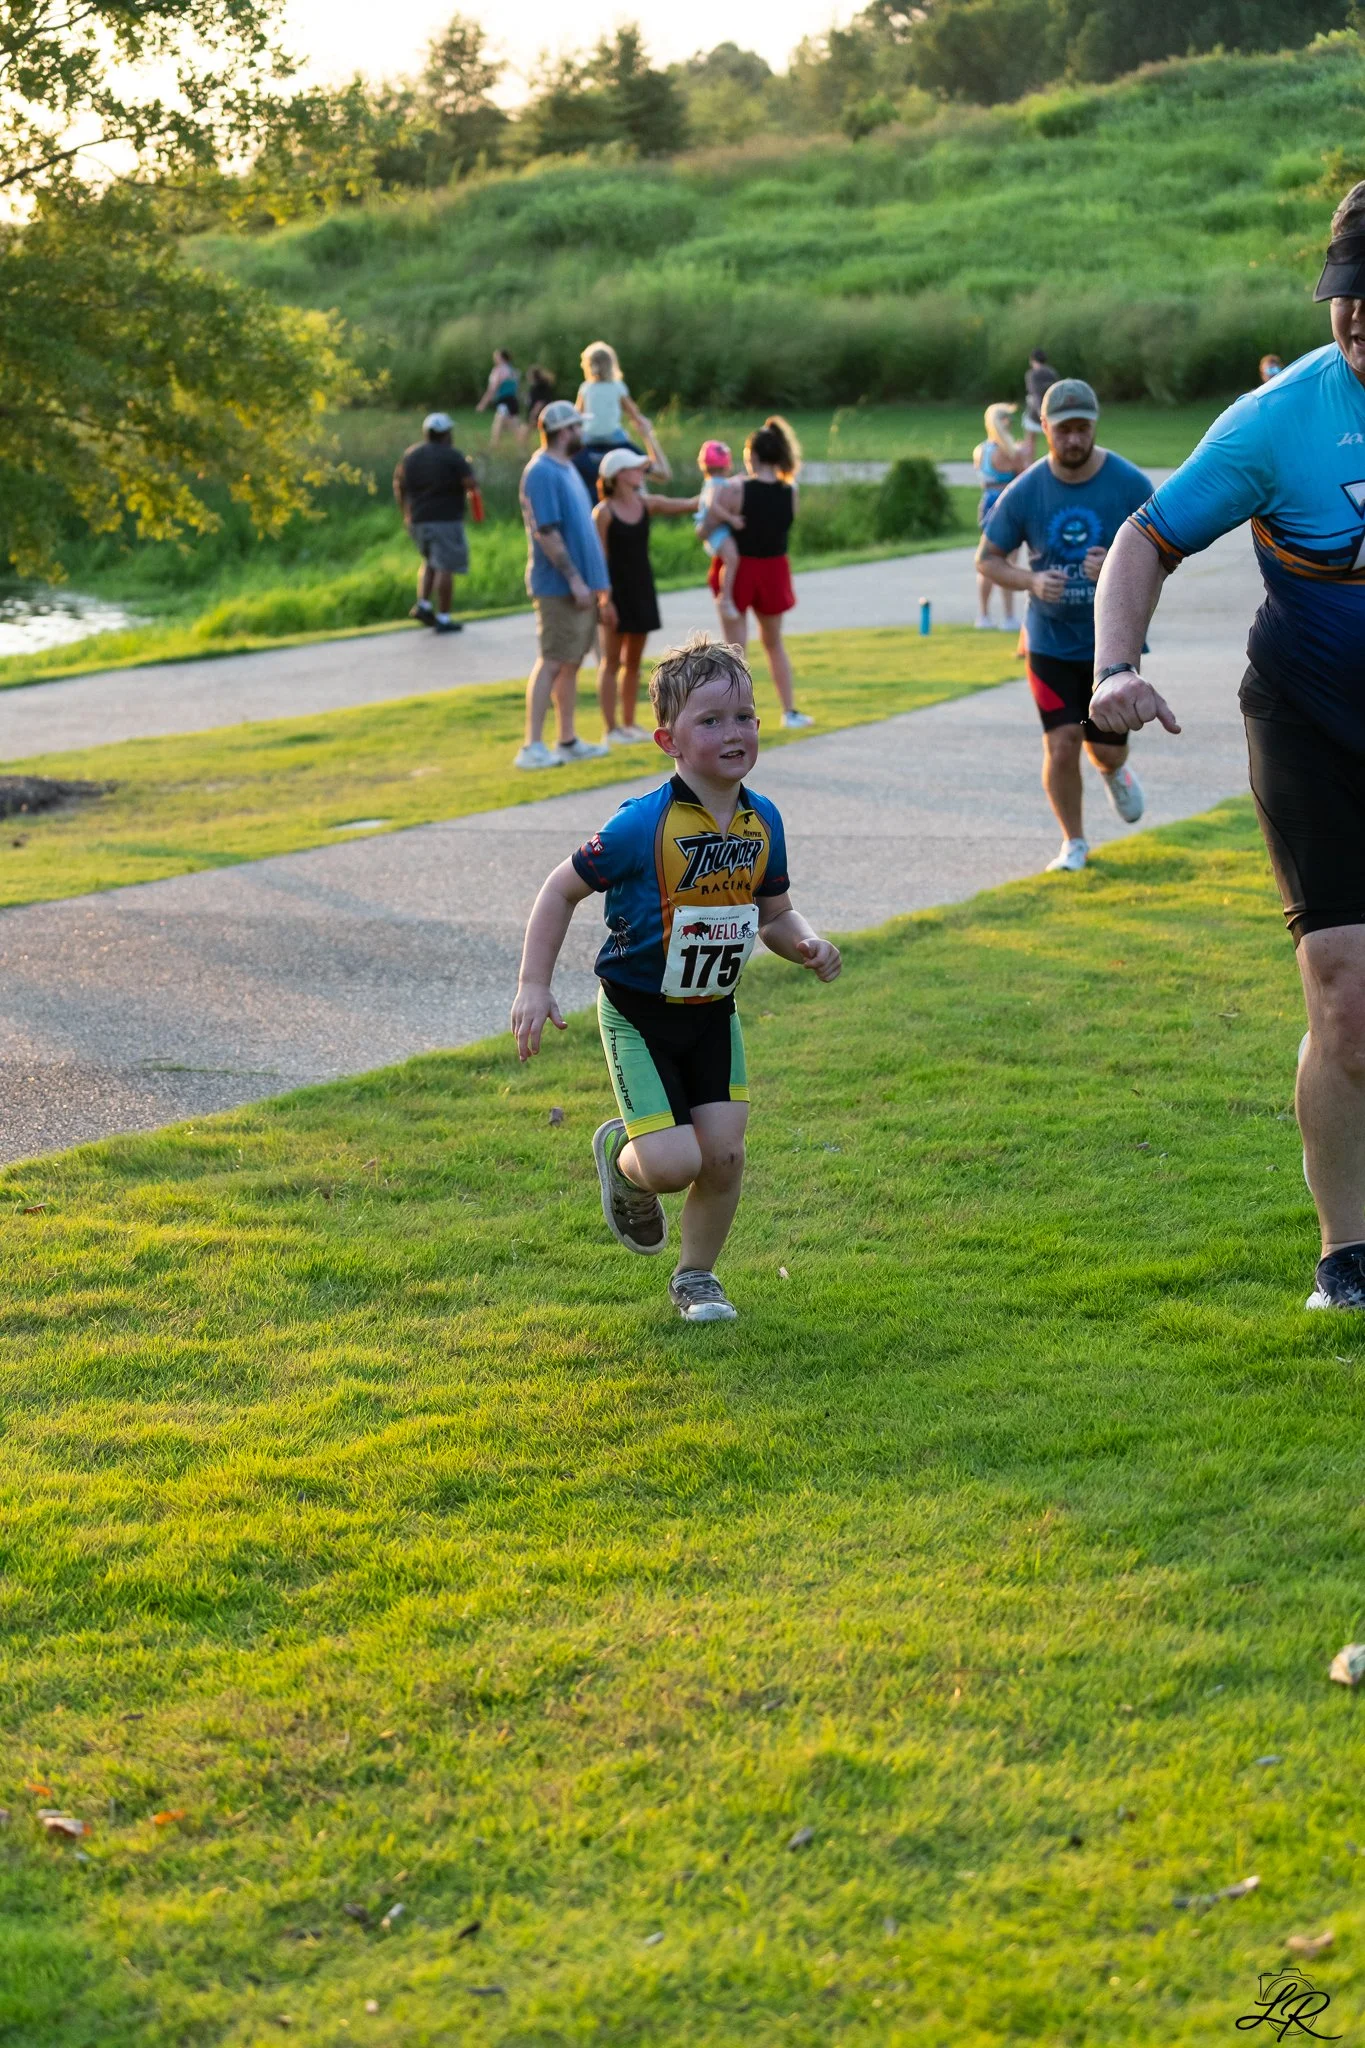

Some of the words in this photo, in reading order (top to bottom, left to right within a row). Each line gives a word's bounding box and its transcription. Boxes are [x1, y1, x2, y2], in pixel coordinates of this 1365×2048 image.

[673, 831, 764, 893] THUNDER
[701, 880, 751, 895] RACING
[708, 922, 737, 940] VELO
[680, 944, 744, 988] 175
